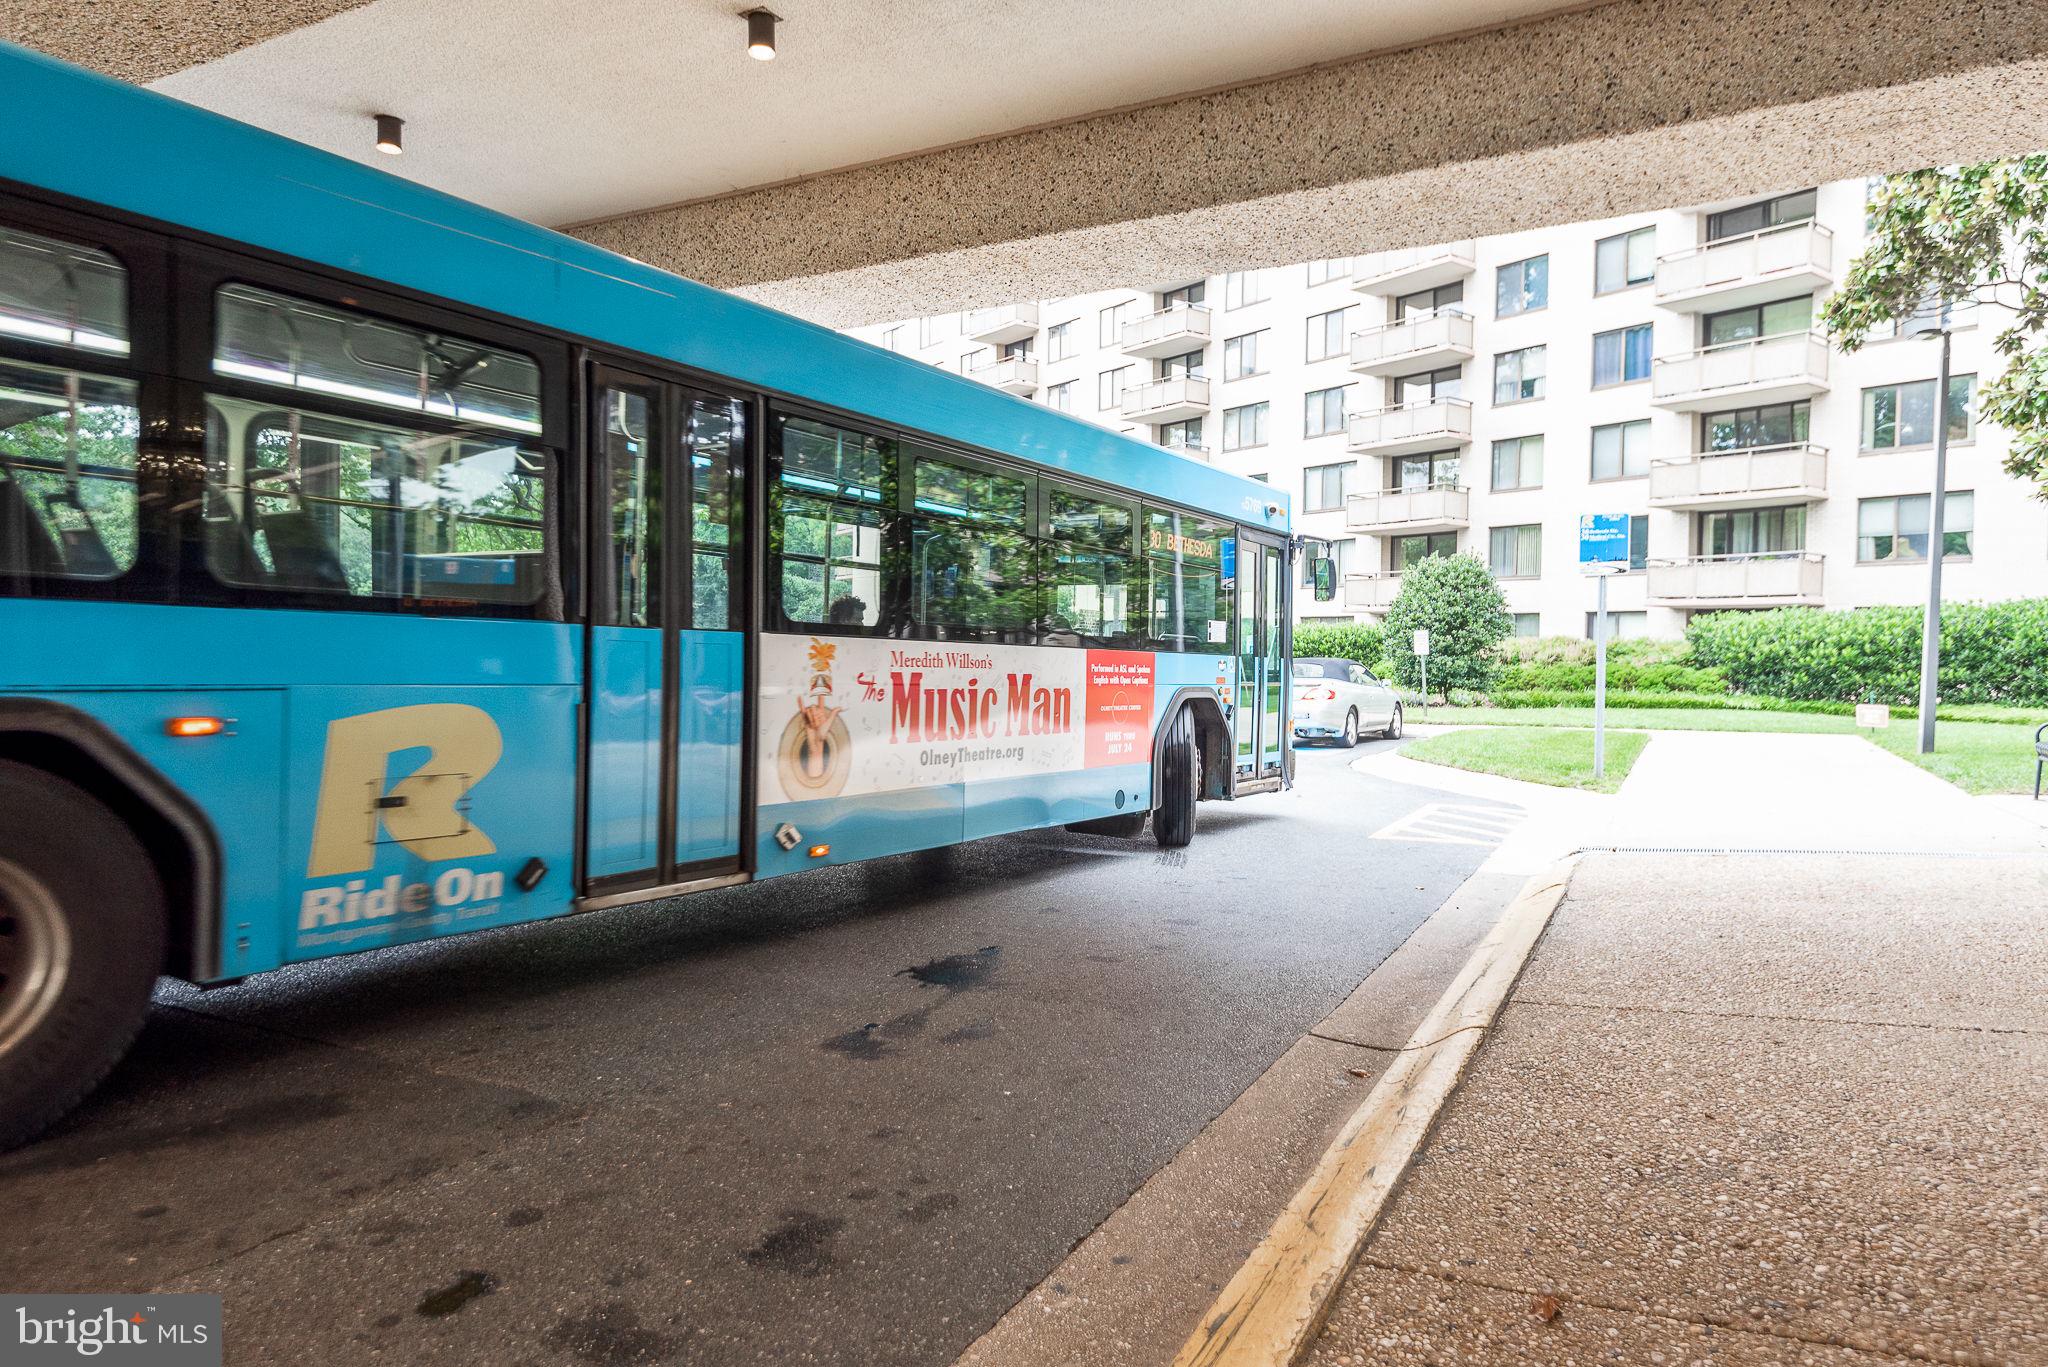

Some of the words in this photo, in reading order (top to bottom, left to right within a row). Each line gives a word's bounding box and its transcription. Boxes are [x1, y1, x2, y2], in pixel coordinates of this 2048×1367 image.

[890, 651, 943, 667] Meredith
[945, 652, 993, 669] Willson's
[1091, 663, 1114, 672] Performed
[1093, 675, 1109, 686] English
[857, 671, 885, 703] The
[889, 672, 998, 744] Music
[1005, 673, 1071, 736] Man
[920, 747, 1024, 768] OlneyTheatre.org
[307, 703, 503, 878] R
[298, 874, 432, 930] Ride
[435, 867, 504, 905] On
